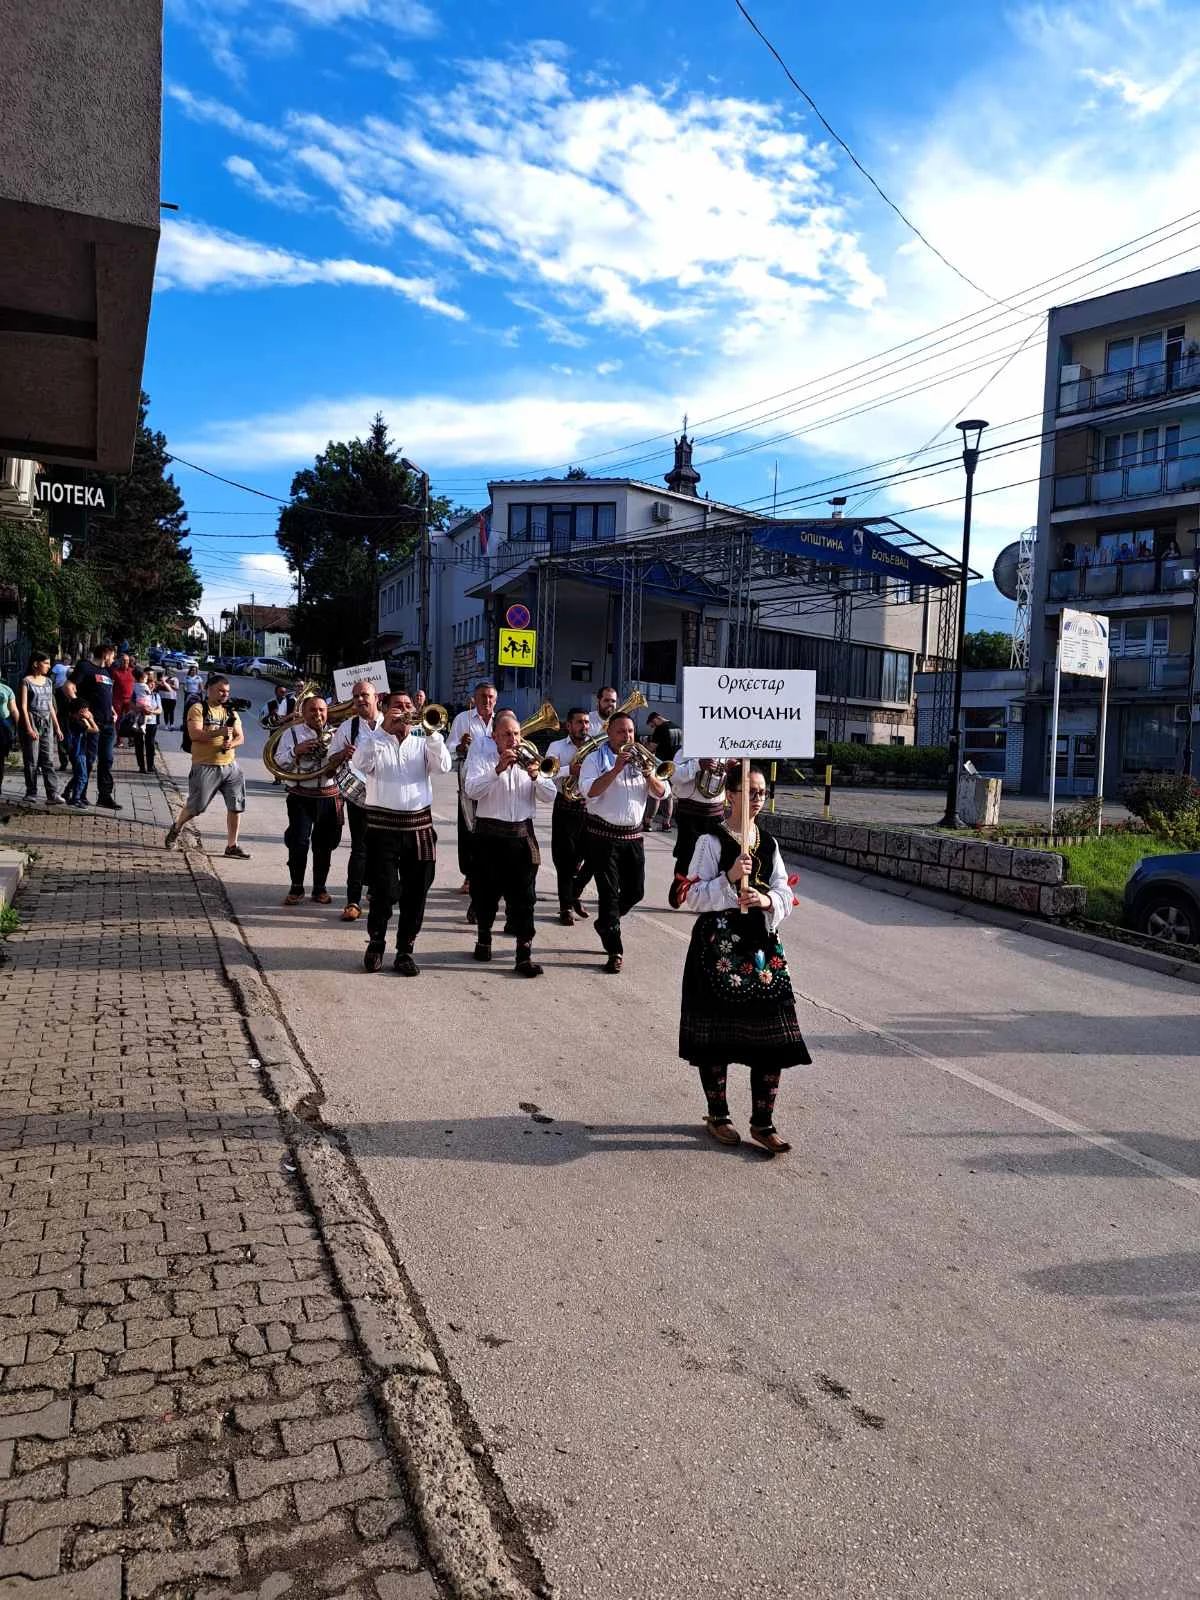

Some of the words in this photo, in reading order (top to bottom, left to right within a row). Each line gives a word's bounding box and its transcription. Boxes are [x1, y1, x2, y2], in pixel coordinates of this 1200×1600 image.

[800, 531, 844, 552] ОПШТИНА
[718, 674, 785, 695] Оркестар
[698, 706, 801, 720] ТИМОЧАНИ
[718, 736, 782, 750] Књажевац
